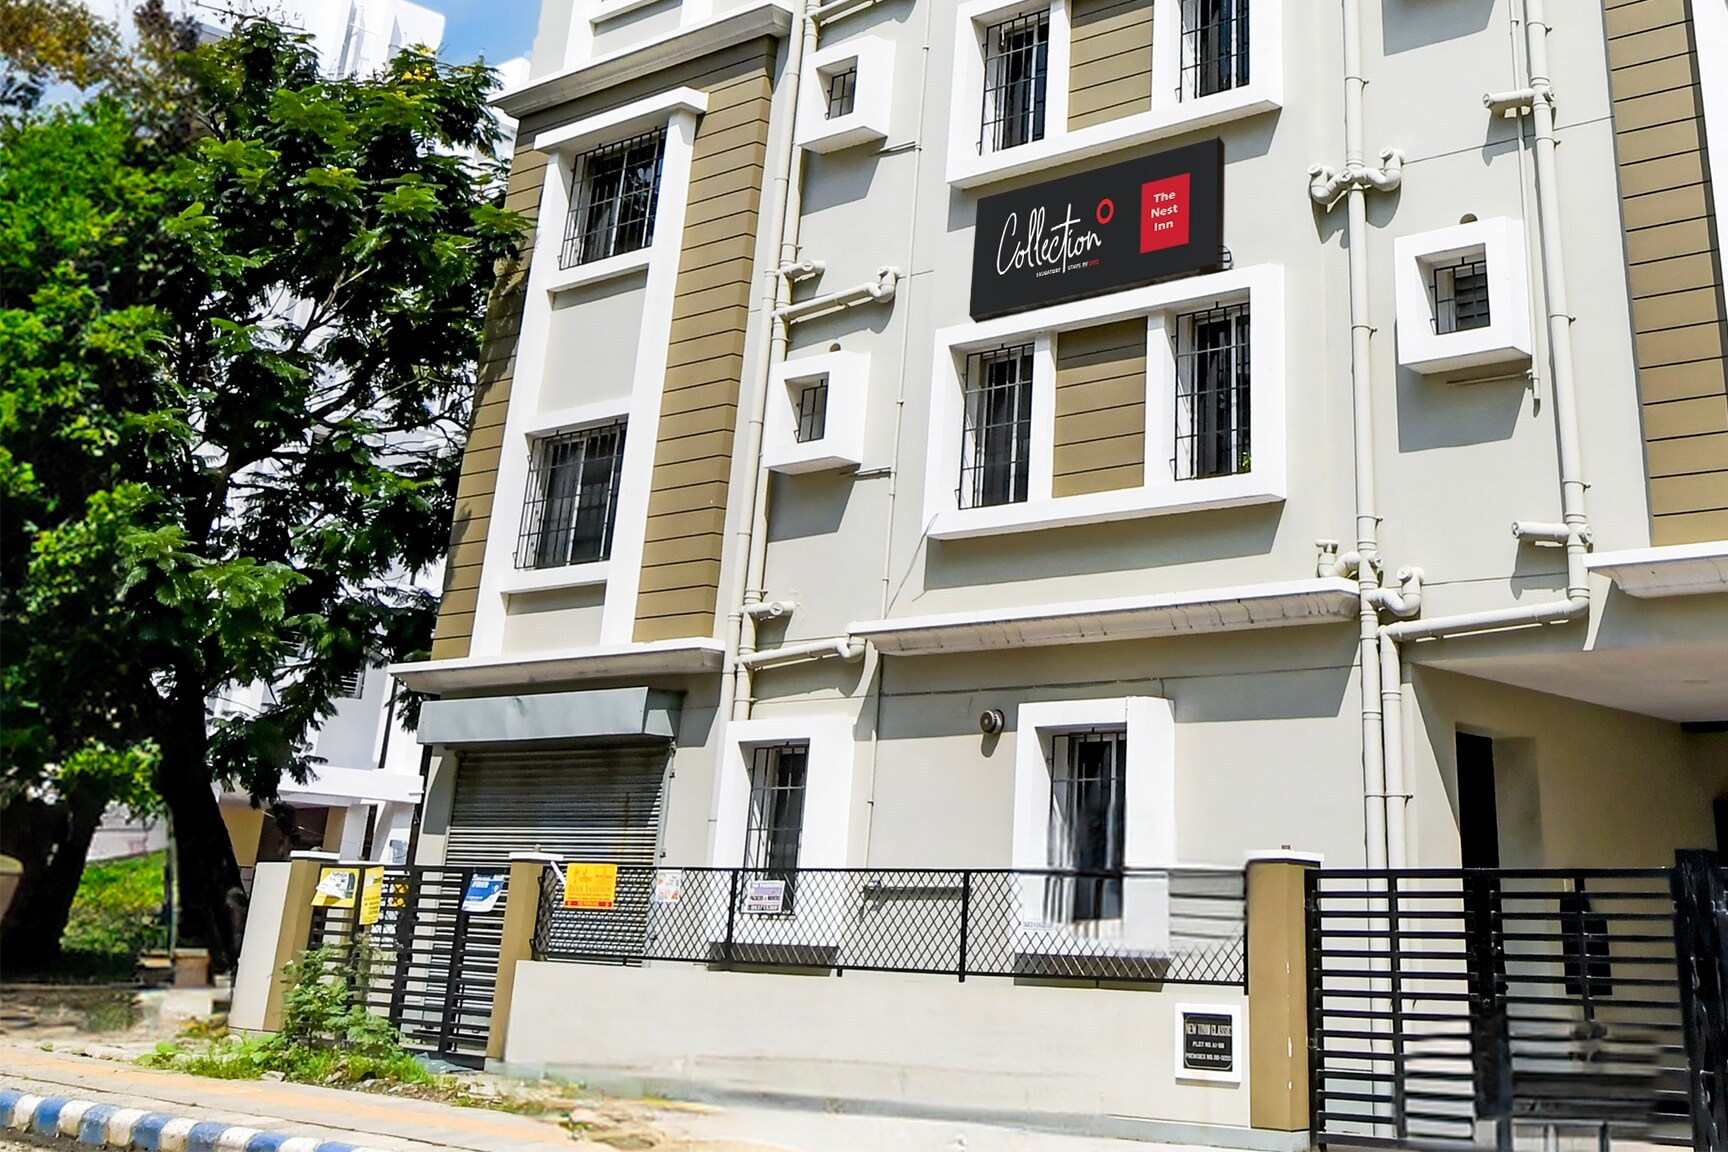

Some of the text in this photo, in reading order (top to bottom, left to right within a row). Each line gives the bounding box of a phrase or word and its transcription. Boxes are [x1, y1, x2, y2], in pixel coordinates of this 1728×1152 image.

[1153, 191, 1176, 203] The
[1151, 204, 1178, 219] Nest
[1154, 221, 1174, 232] Inn
[996, 203, 1102, 275] Collection
